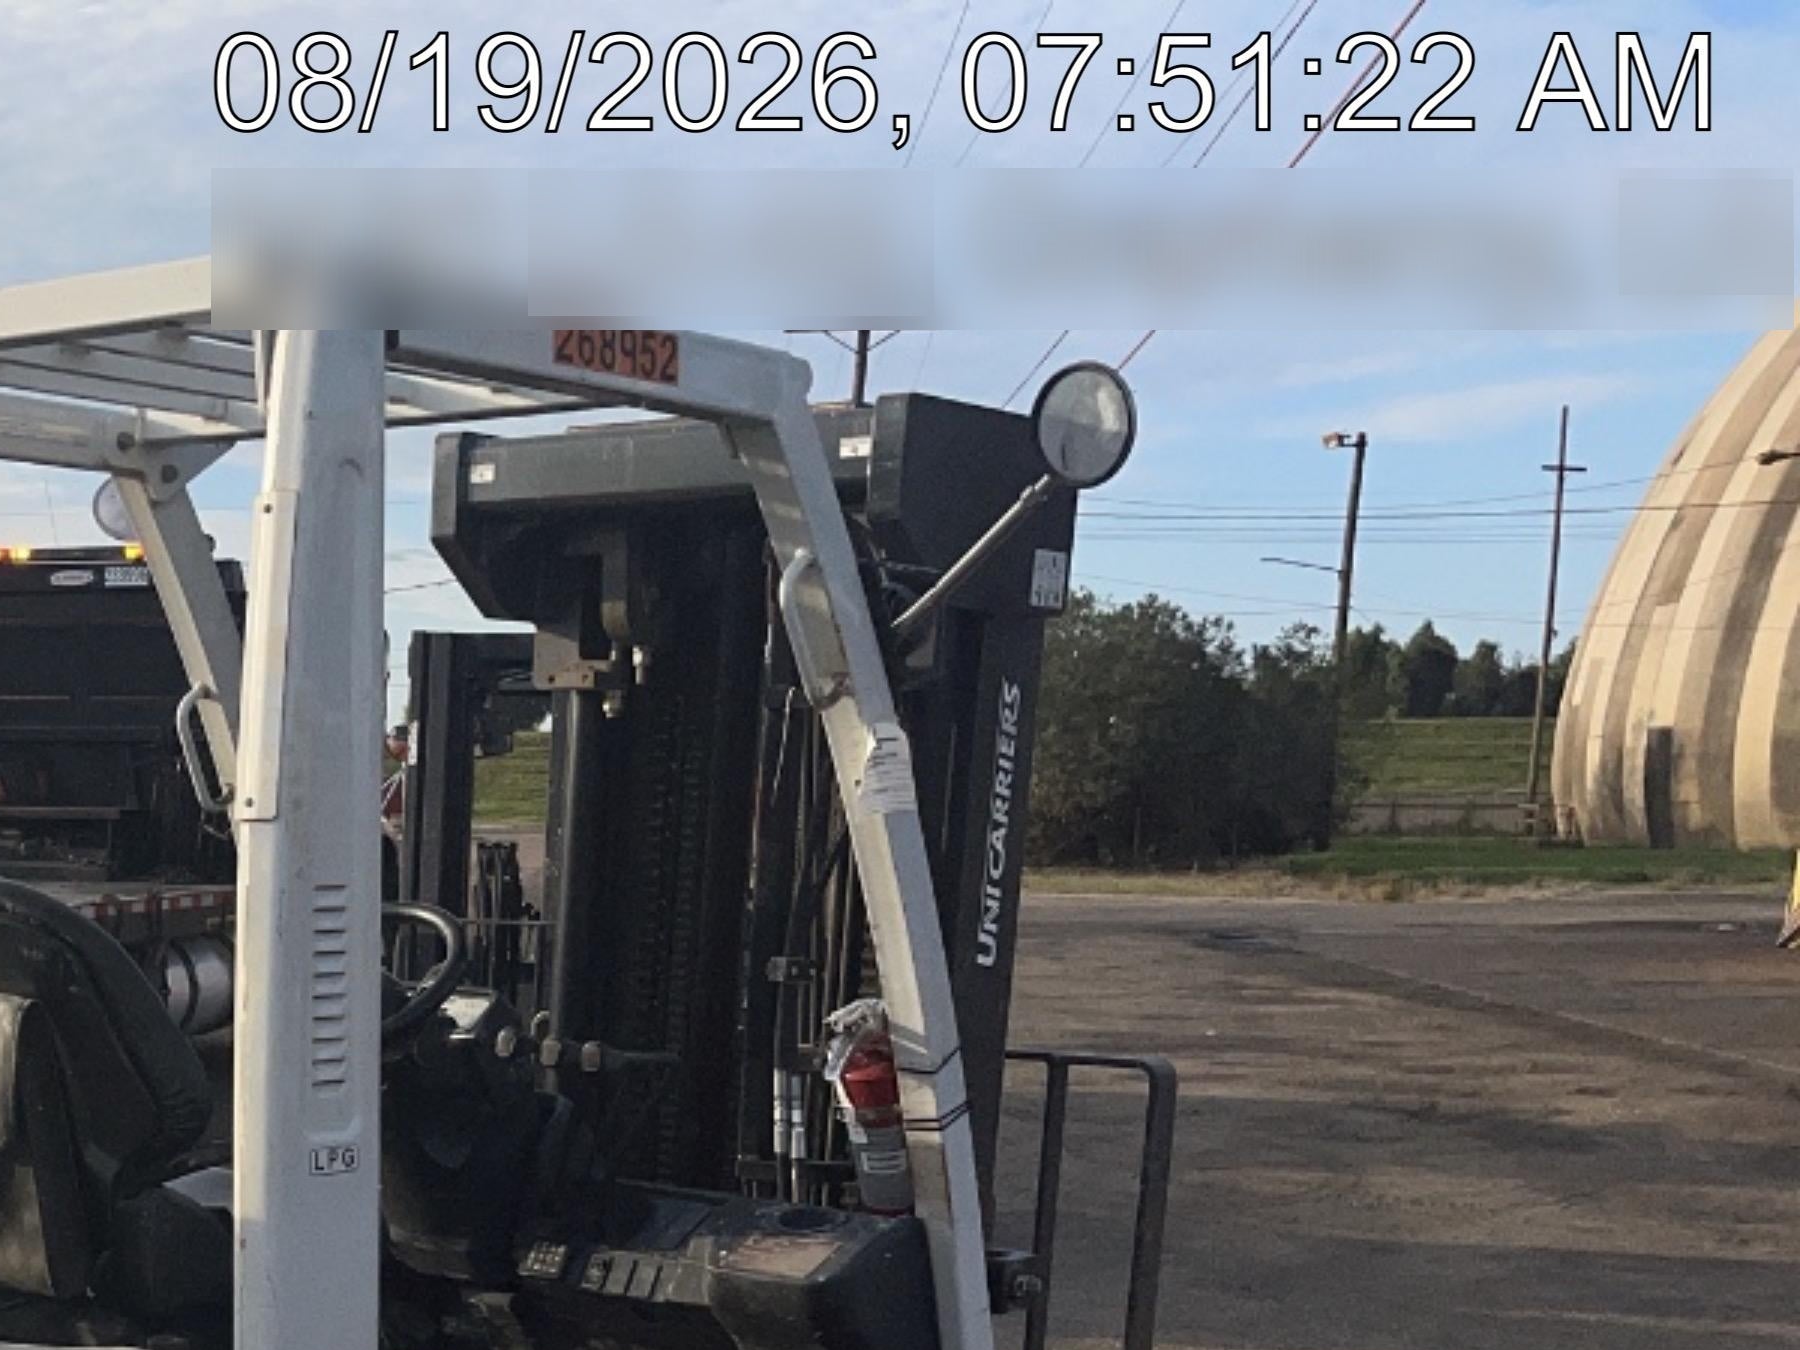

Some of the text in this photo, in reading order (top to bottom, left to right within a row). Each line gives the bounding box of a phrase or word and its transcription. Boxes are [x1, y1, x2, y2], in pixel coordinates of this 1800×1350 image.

[553, 330, 679, 382] 268952
[975, 680, 1021, 968] UNICARRIERS
[312, 1146, 356, 1171] LPG
